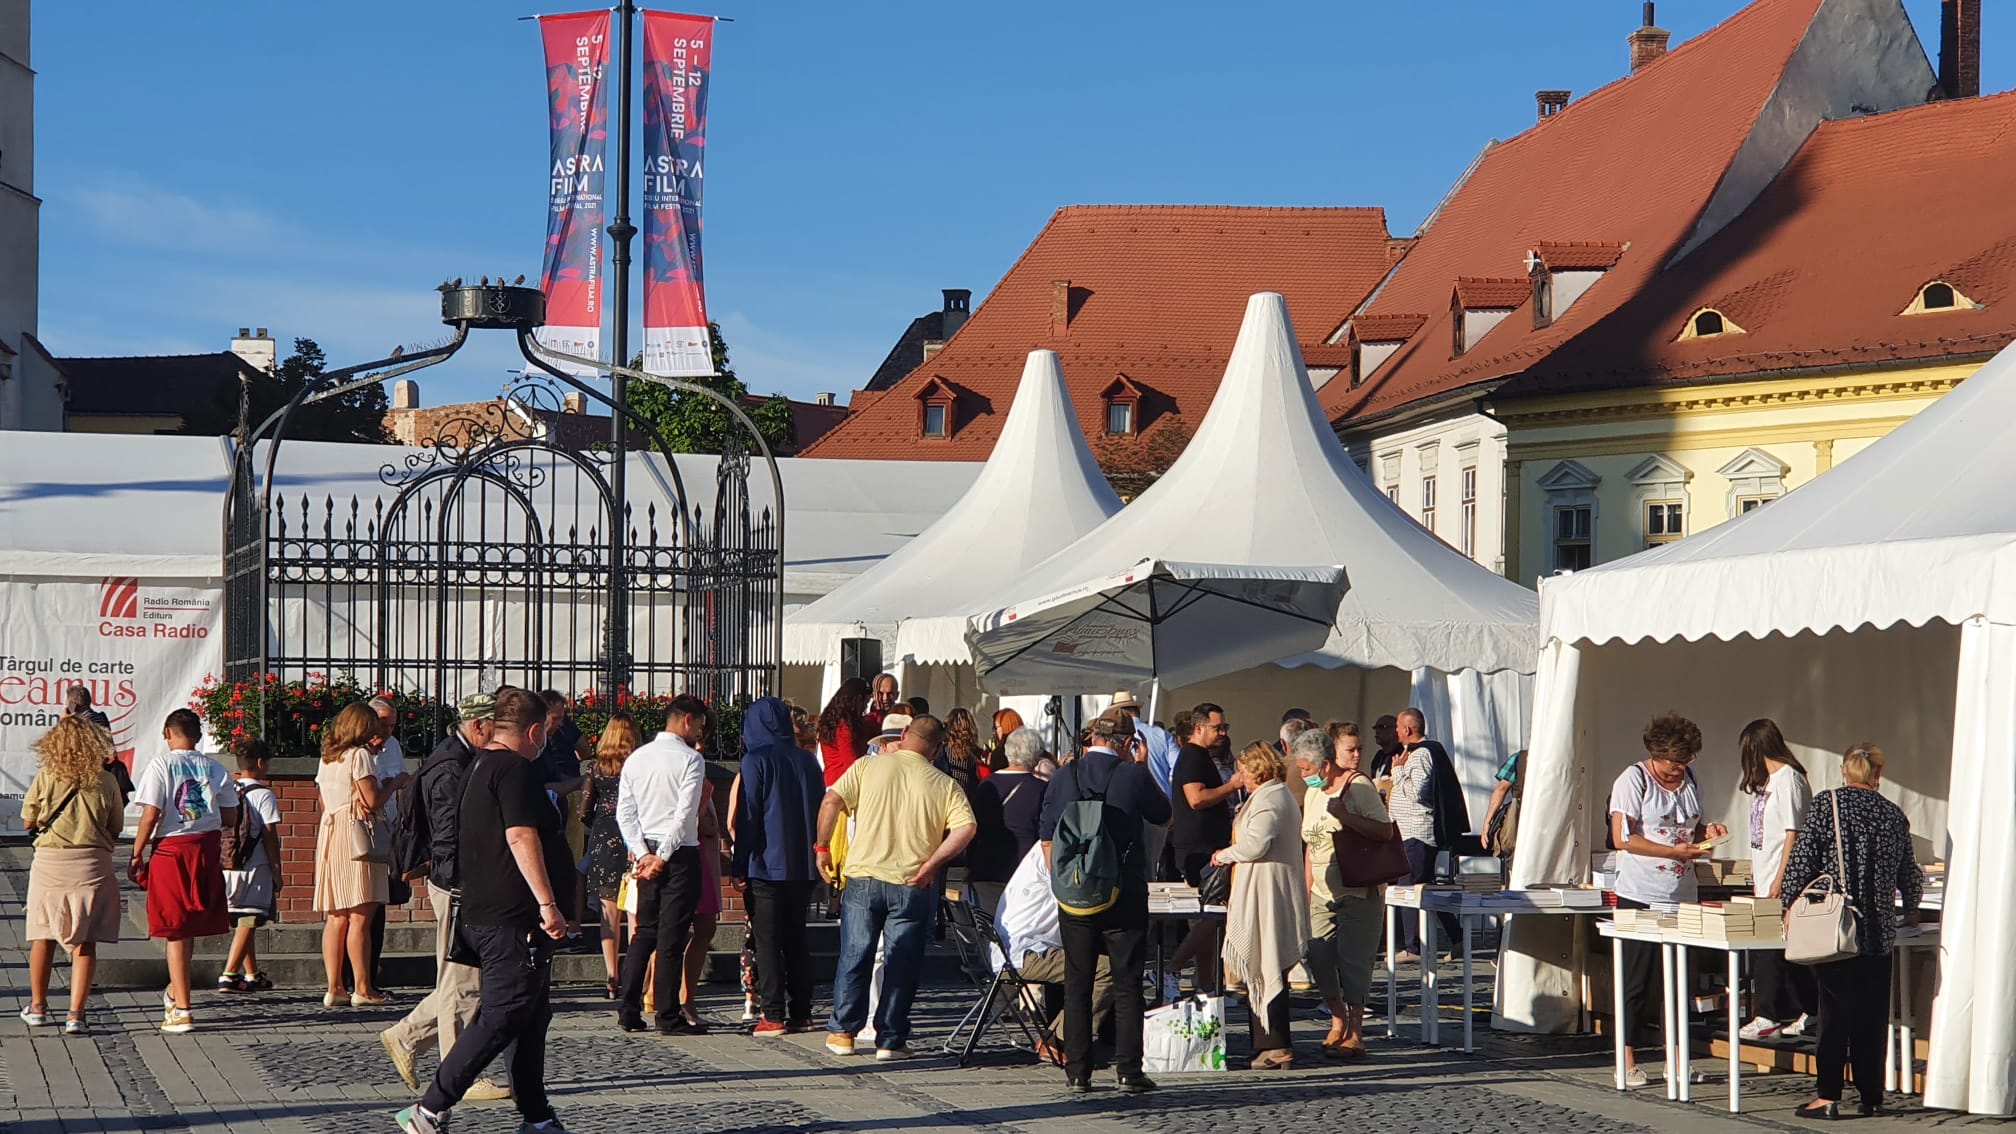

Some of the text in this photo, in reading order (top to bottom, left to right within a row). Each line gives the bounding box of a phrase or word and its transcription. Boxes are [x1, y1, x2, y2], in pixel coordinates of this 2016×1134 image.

[592, 34, 603, 44] 5
[690, 40, 704, 49] 5
[688, 71, 701, 86] 12
[670, 38, 687, 140] SEPTEMBRIE
[552, 153, 603, 176] ASRA
[645, 155, 703, 178] ASTRA
[645, 175, 685, 195] FILM
[144, 597, 210, 606] Radio România
[143, 612, 173, 620] Editura
[99, 621, 208, 639] Casa Radio
[0, 656, 134, 675] Târgul de carte
